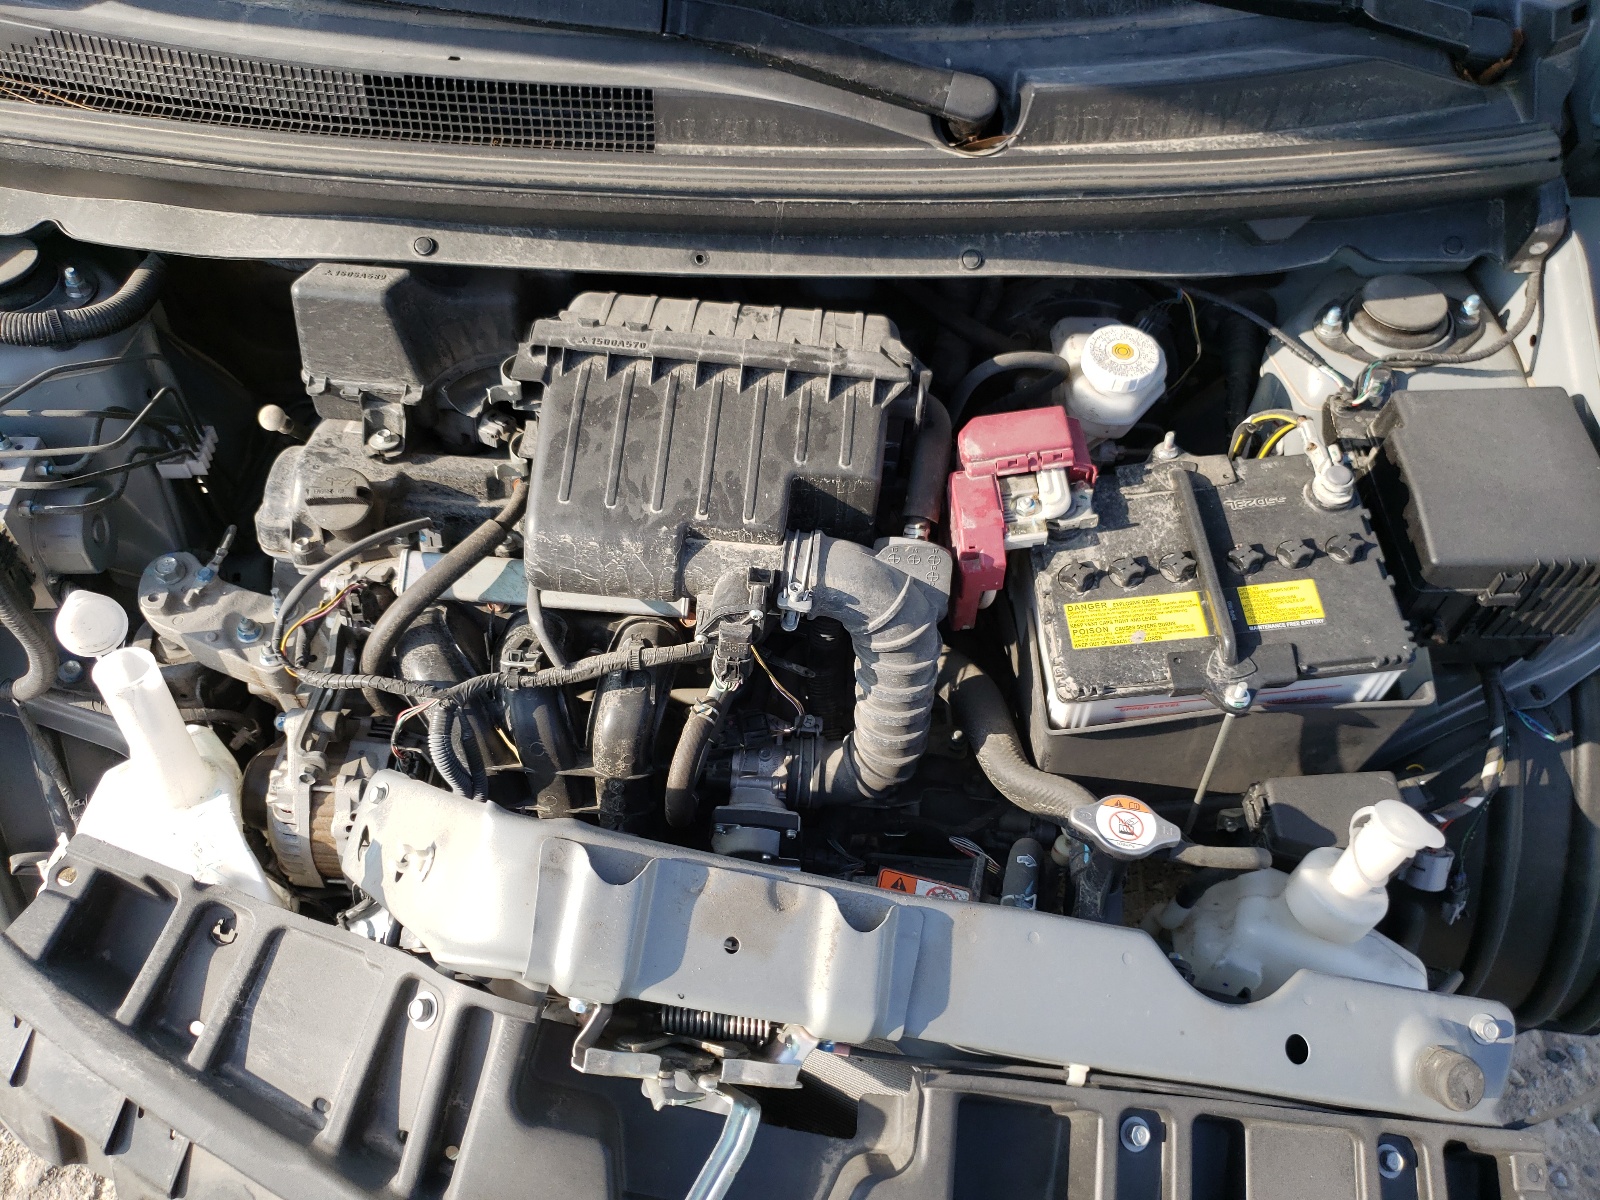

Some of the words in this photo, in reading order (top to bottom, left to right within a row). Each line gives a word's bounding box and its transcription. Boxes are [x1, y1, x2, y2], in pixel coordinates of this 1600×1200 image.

[1067, 602, 1108, 612] DANGER
[1300, 618, 1324, 626] BATTERY
[1073, 627, 1109, 636] POISON
